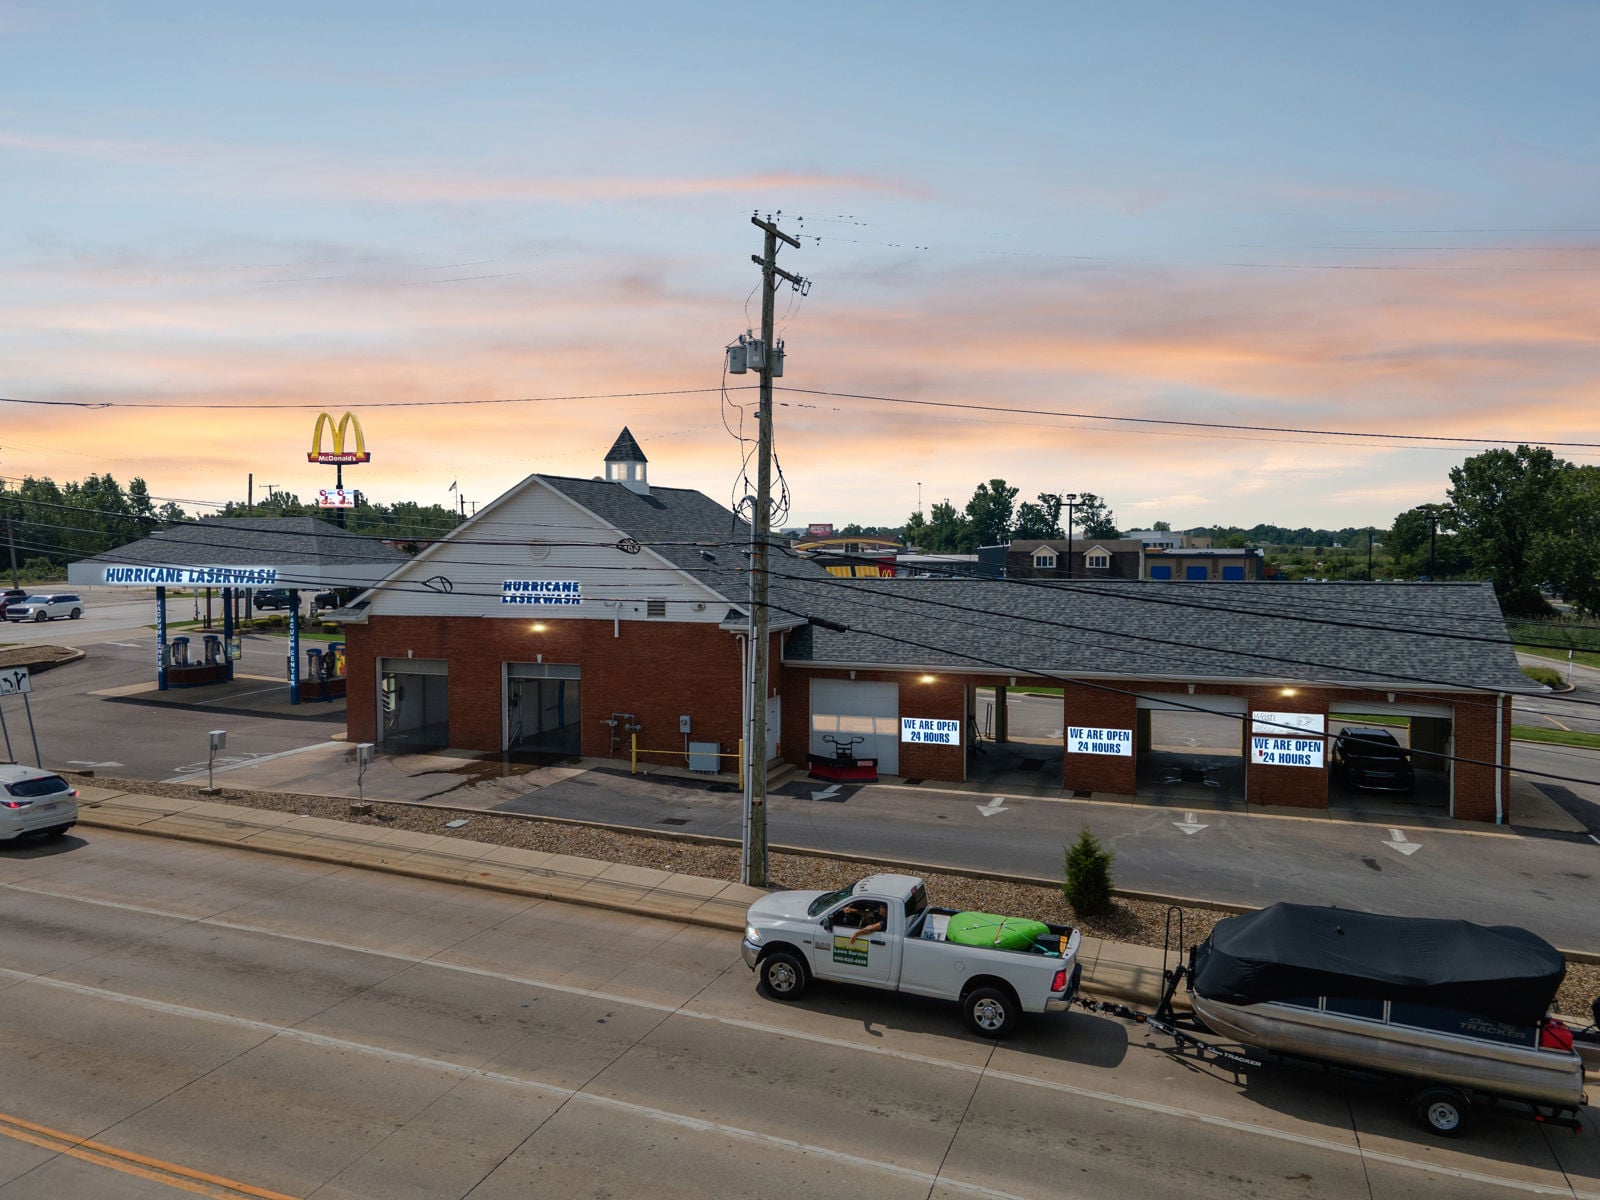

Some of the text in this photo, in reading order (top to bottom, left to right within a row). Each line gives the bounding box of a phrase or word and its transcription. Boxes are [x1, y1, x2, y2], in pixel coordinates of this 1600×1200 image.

[105, 567, 277, 584] HURRICANE LASERWASH
[503, 581, 580, 592] HURRICANE
[501, 593, 581, 604] LASERWASH
[903, 718, 958, 732] WE ARE OPEN
[911, 731, 950, 744] 24 HOURS
[1069, 727, 1130, 742] WE ARE OPEN
[1077, 741, 1121, 754] 24 HOURS
[1254, 738, 1321, 753] WE ARE OPEN
[1263, 752, 1312, 766] 24 HOURS
[1460, 1022, 1527, 1040] TRACKER
[1223, 1052, 1262, 1067] TRACKER
